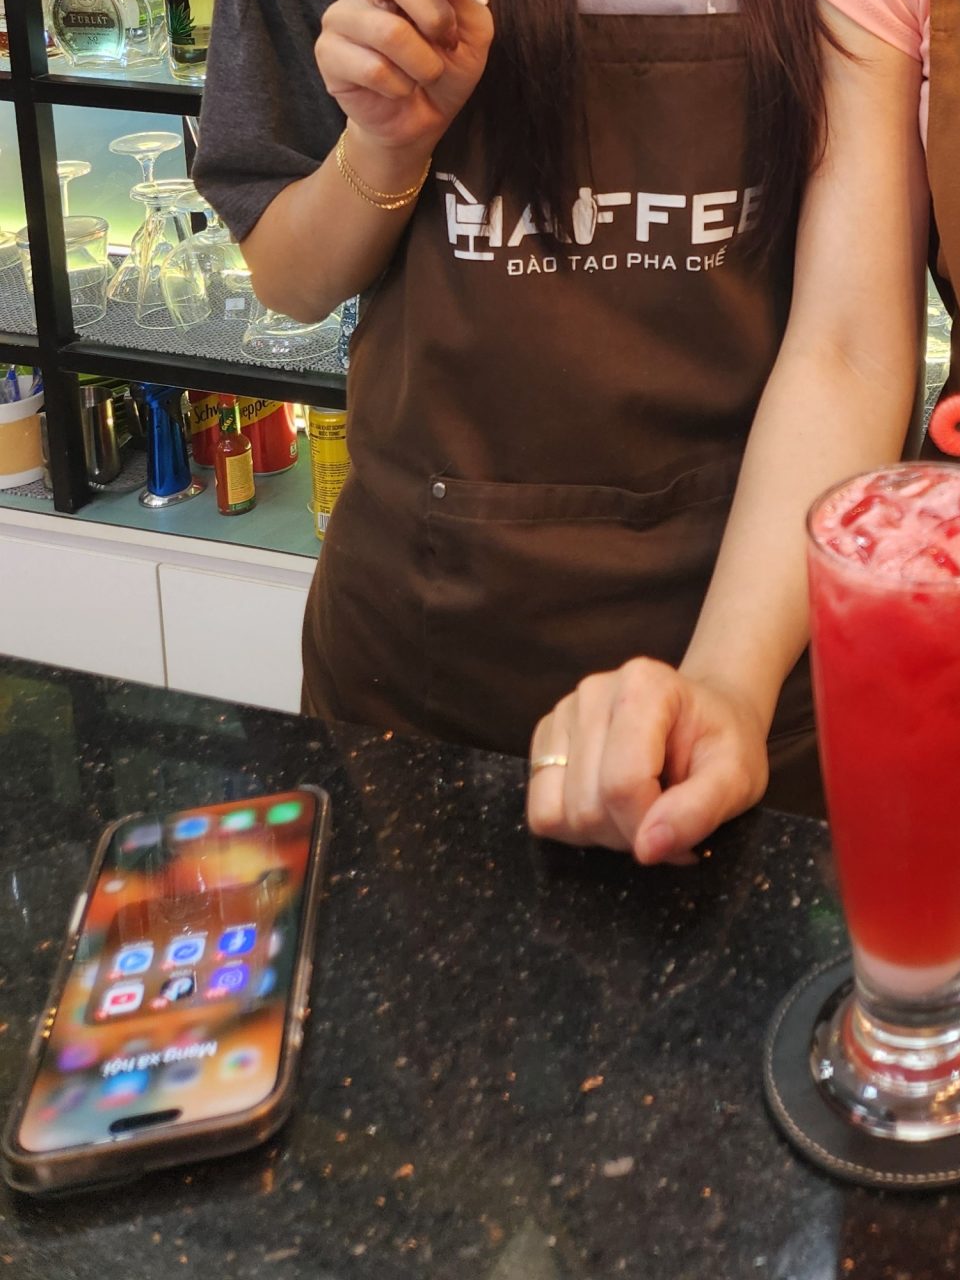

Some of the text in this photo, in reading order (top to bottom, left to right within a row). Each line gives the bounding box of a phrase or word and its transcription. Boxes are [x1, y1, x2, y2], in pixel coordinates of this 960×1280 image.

[506, 253, 558, 276] ĐÀO
[568, 253, 618, 274] TẠO
[626, 252, 678, 271] PHA
